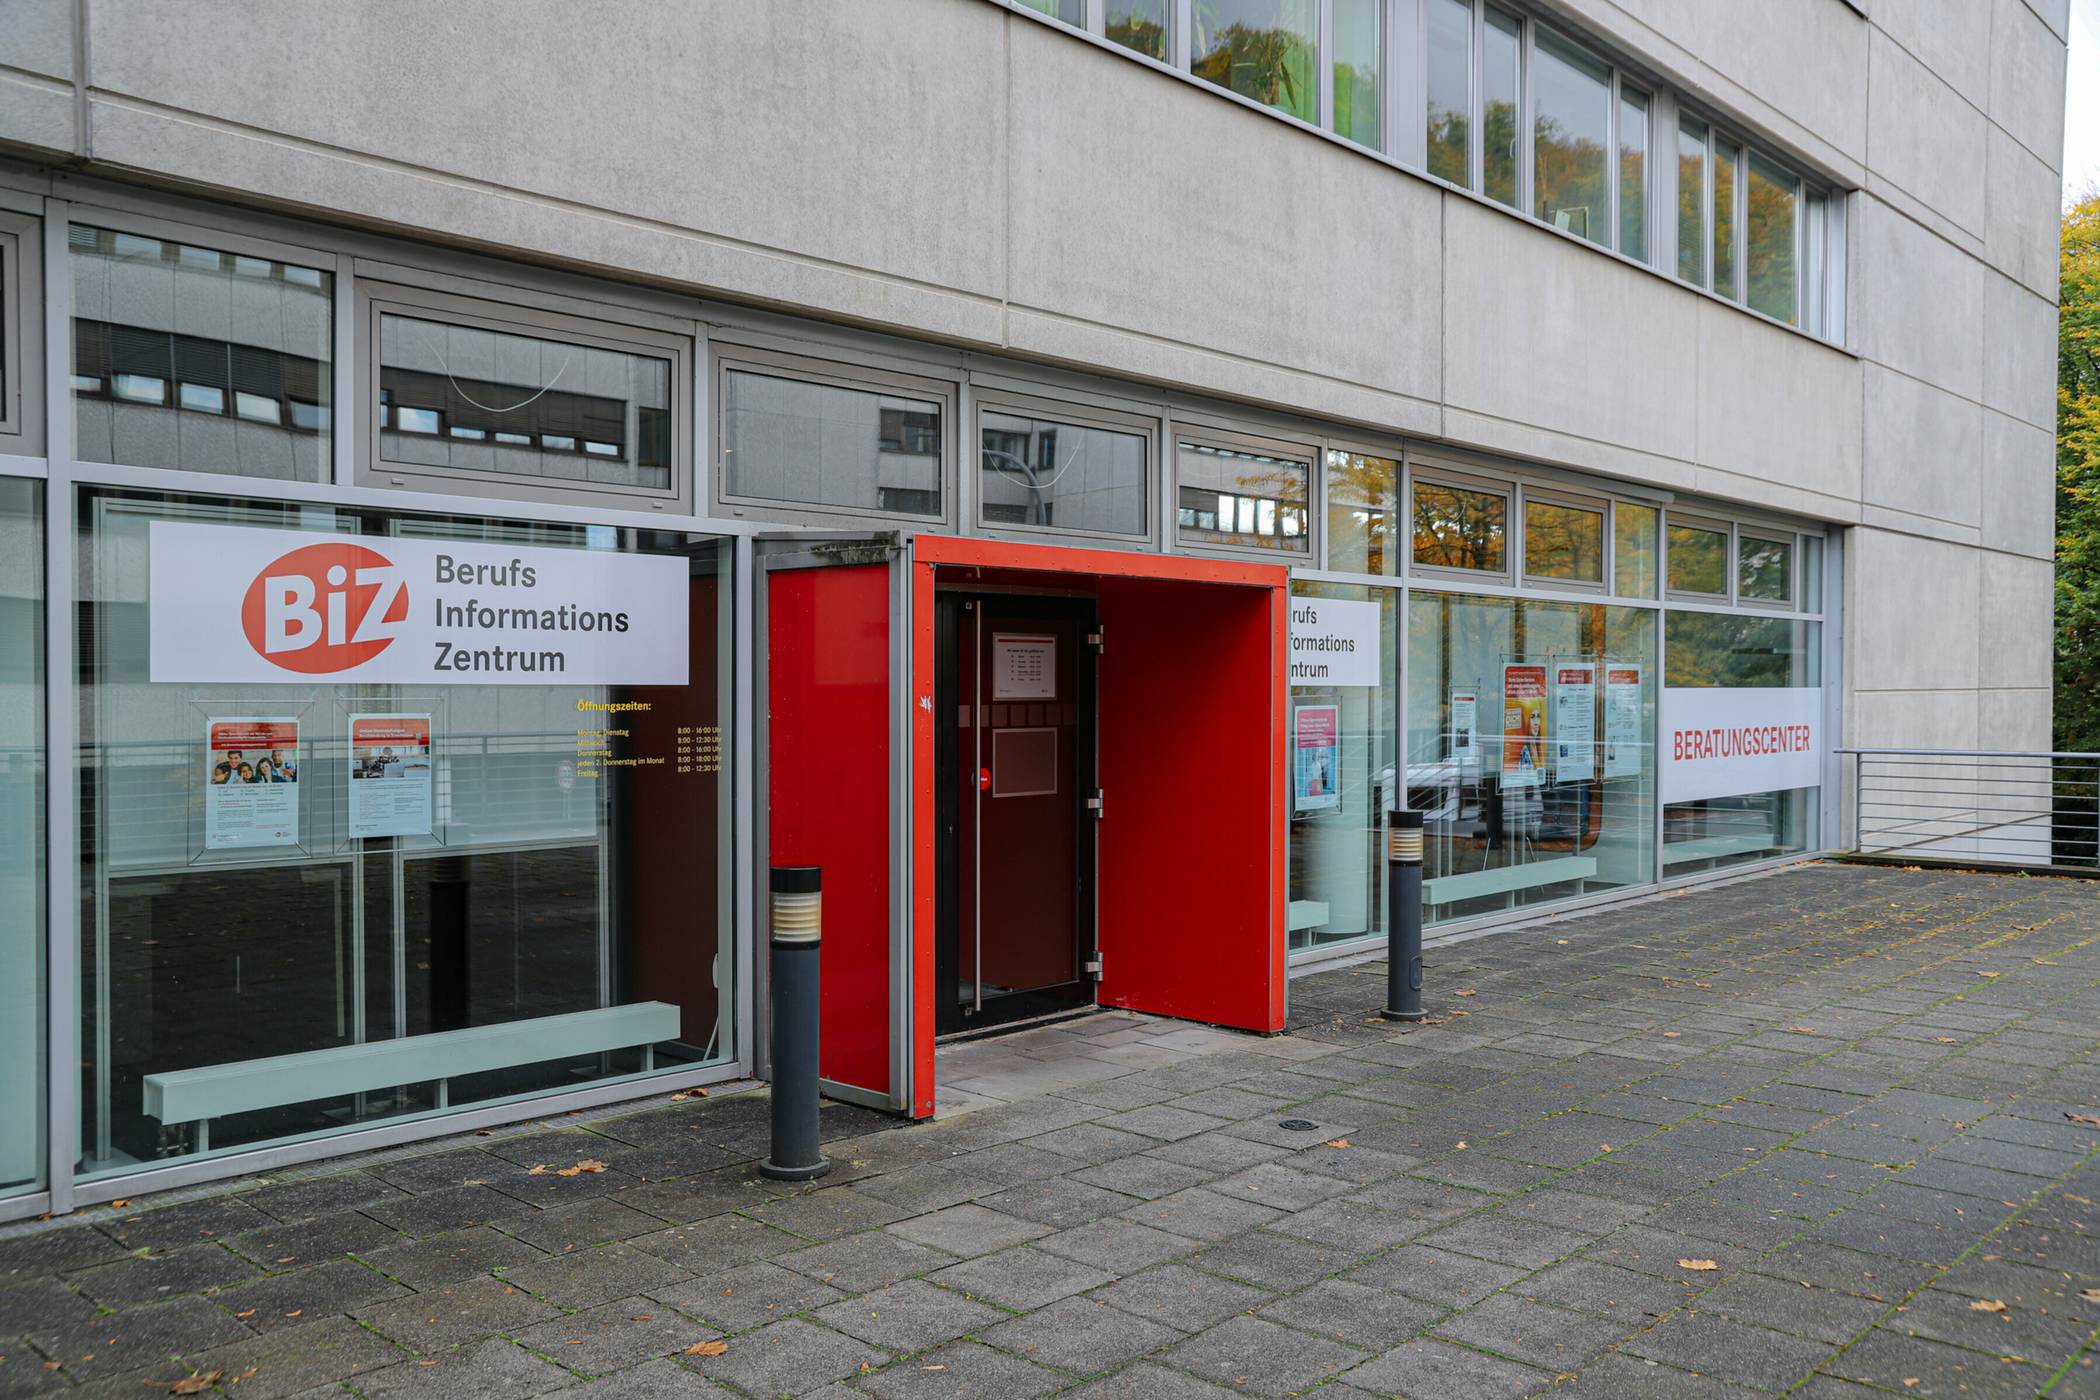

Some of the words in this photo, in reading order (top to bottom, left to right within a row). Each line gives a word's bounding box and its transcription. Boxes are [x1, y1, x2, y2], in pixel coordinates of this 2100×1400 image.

[435, 554, 537, 588] Berufs
[264, 564, 406, 654] BiZ
[435, 598, 629, 633] Informations
[1292, 606, 1317, 624] rufs
[434, 642, 566, 672] Zentrum
[1291, 661, 1328, 678] ntrum
[577, 700, 652, 713] Öffnungszeiten:
[1674, 725, 1810, 760] BERATUNGSCENTER
